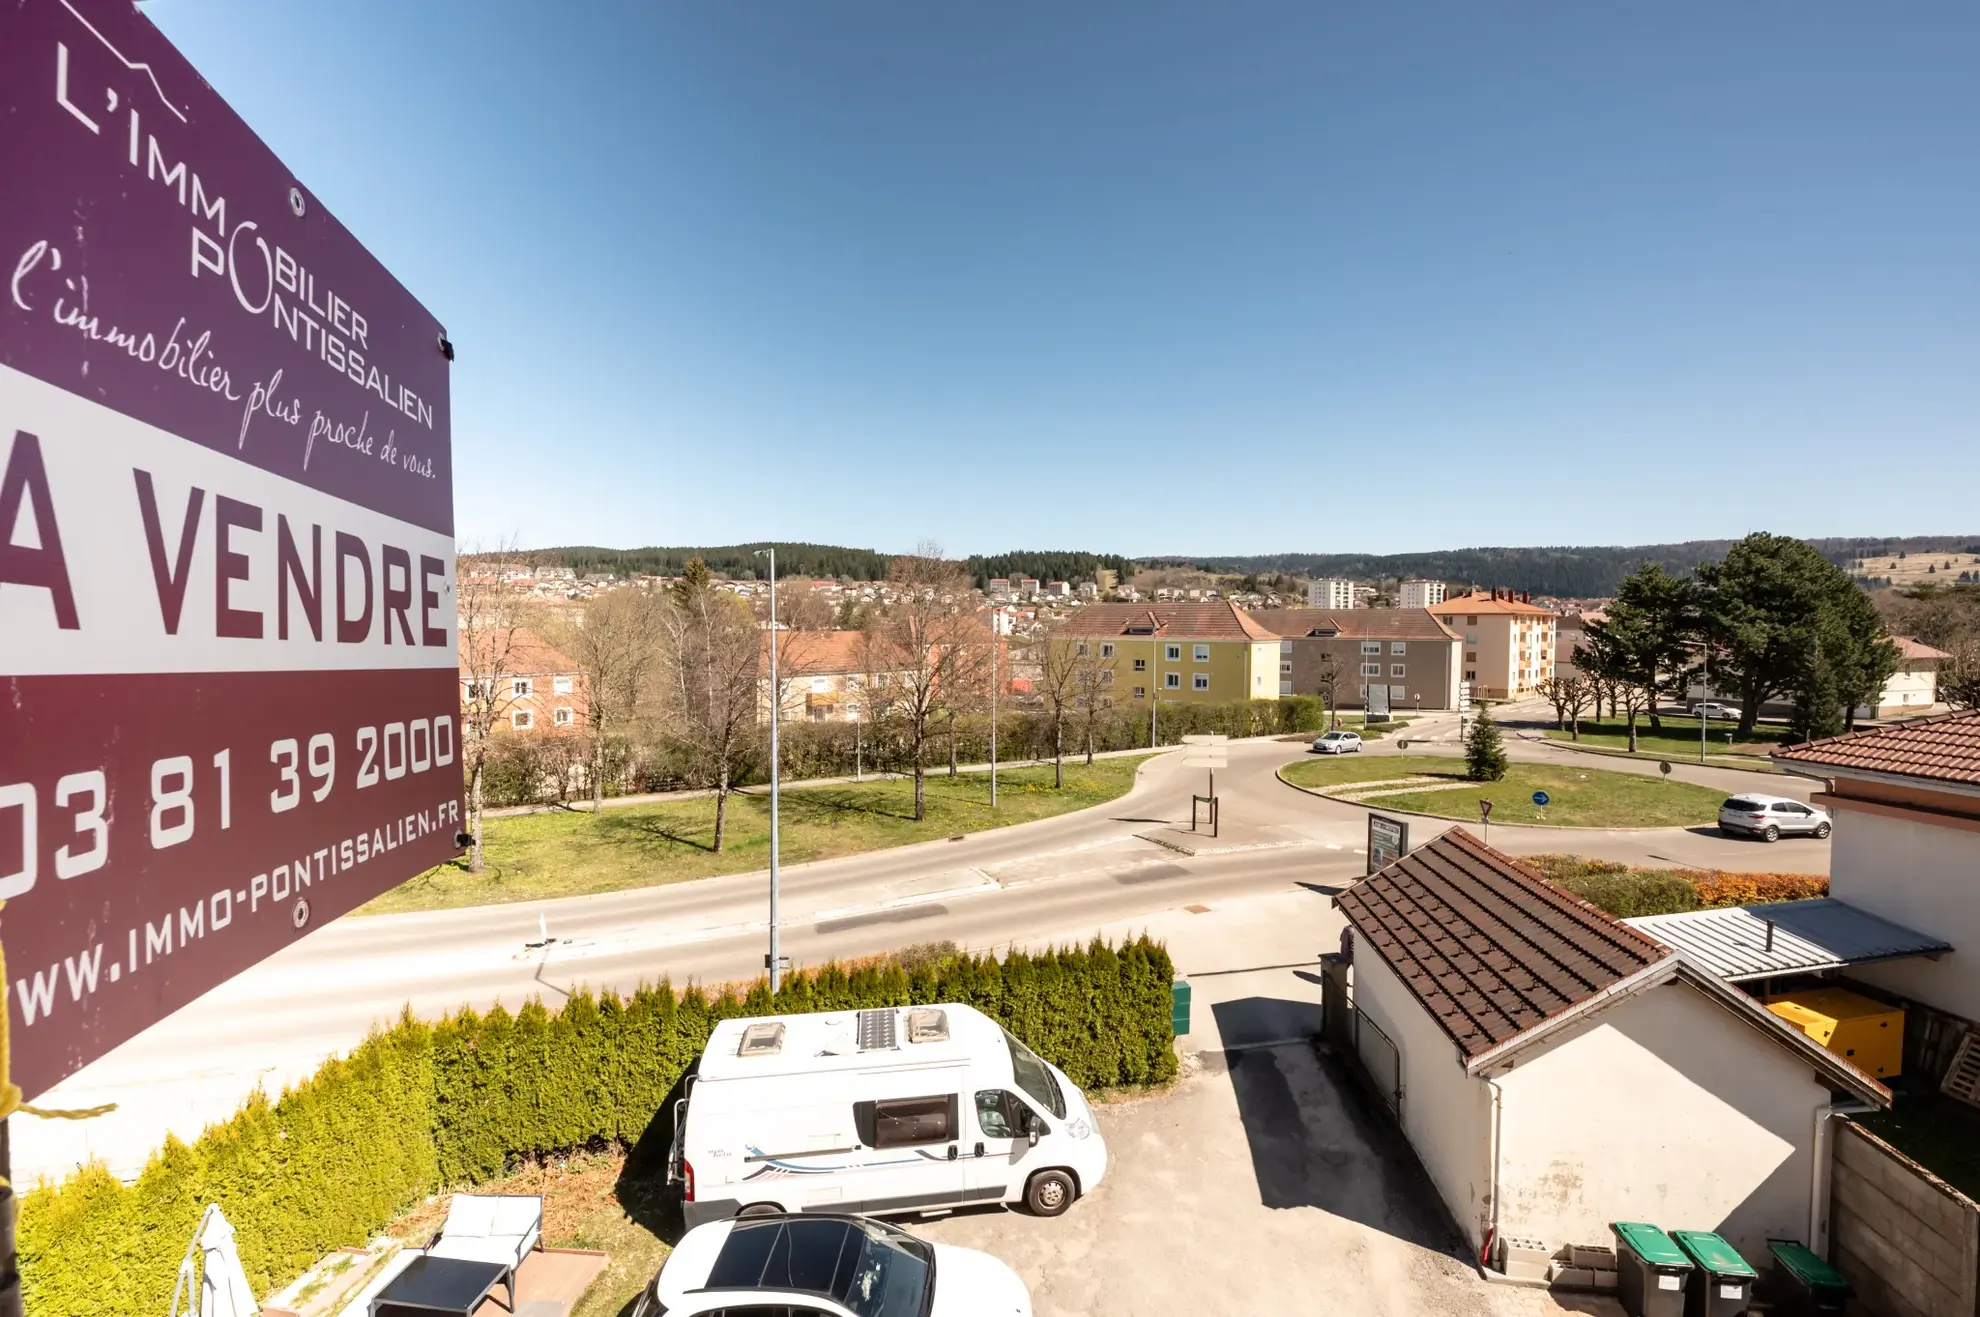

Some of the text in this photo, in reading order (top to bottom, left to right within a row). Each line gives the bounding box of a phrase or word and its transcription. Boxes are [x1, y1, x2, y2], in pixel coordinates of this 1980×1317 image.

[11, 240, 241, 401] l'immobilier
[238, 368, 302, 449] plus
[303, 411, 374, 471] proche
[380, 430, 398, 465] de
[133, 467, 448, 648] VENDRE
[150, 749, 231, 850] 81
[269, 732, 336, 814] 39
[355, 714, 454, 790] 2000
[3, 798, 460, 1028] WW.IMMO-PONTISSALIEN.FR
